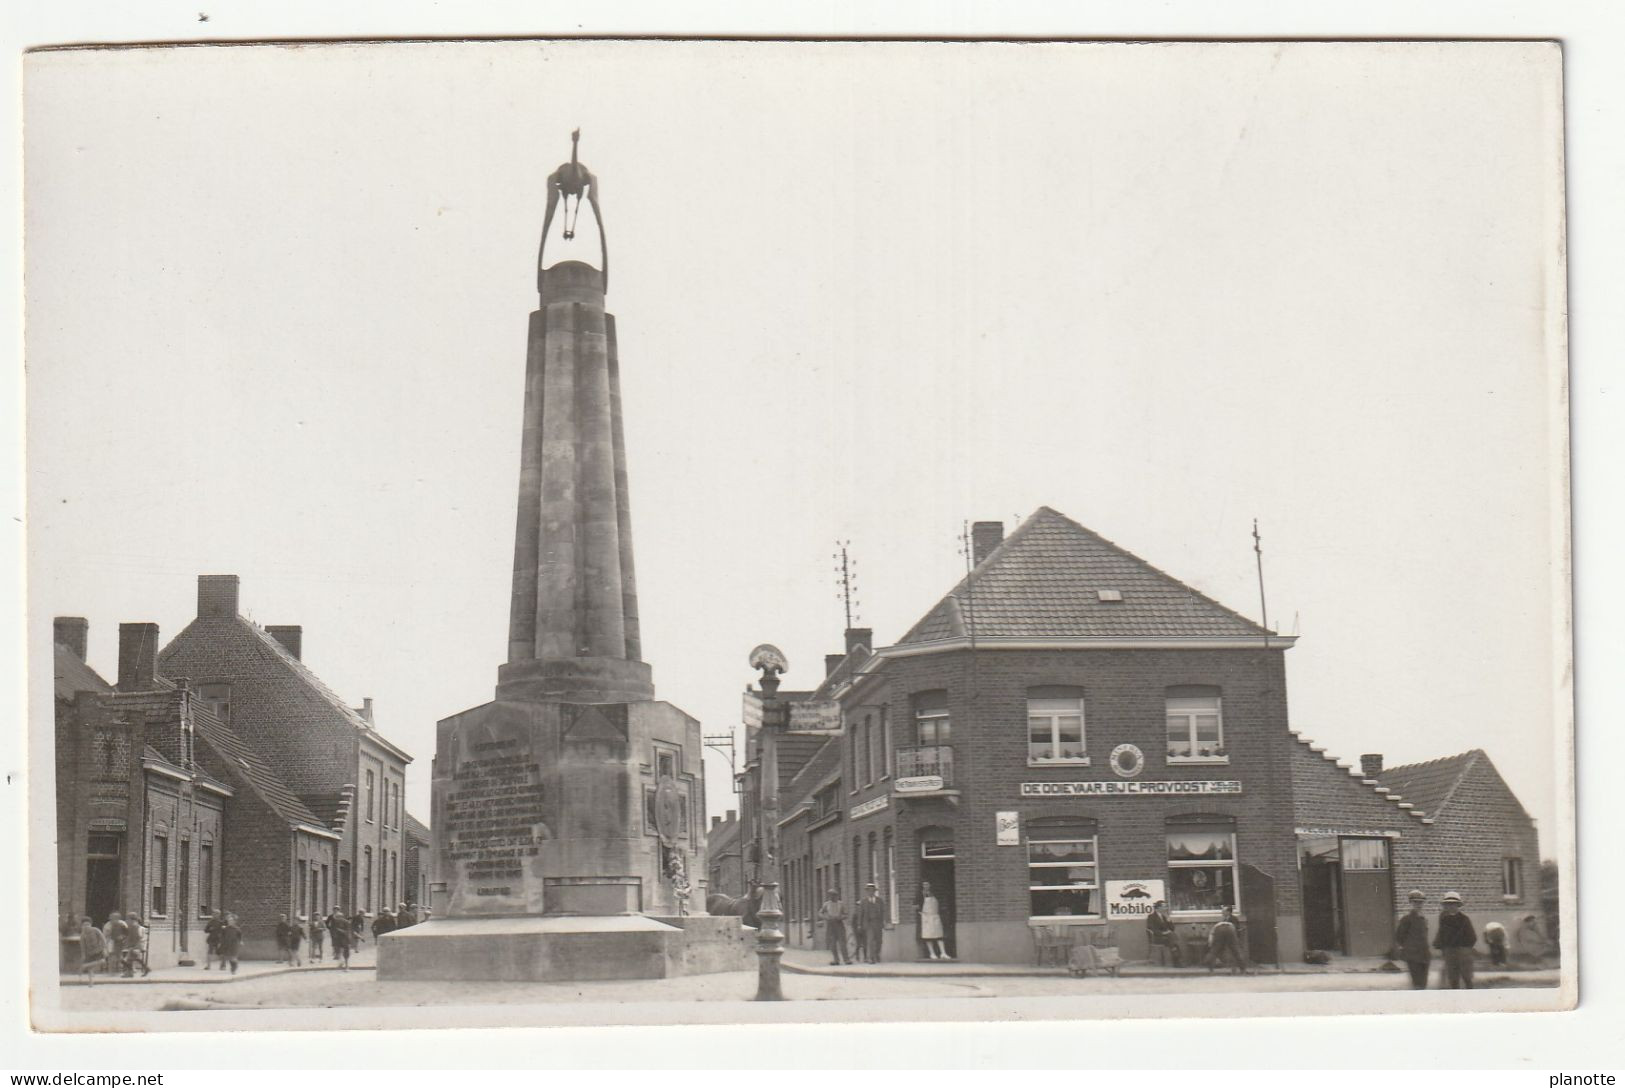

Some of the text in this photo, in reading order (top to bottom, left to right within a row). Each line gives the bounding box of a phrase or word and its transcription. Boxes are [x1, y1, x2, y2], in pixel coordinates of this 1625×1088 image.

[1023, 783, 1041, 794] DE
[1106, 783, 1126, 793] BIJ
[1110, 902, 1154, 915] Mobilo
